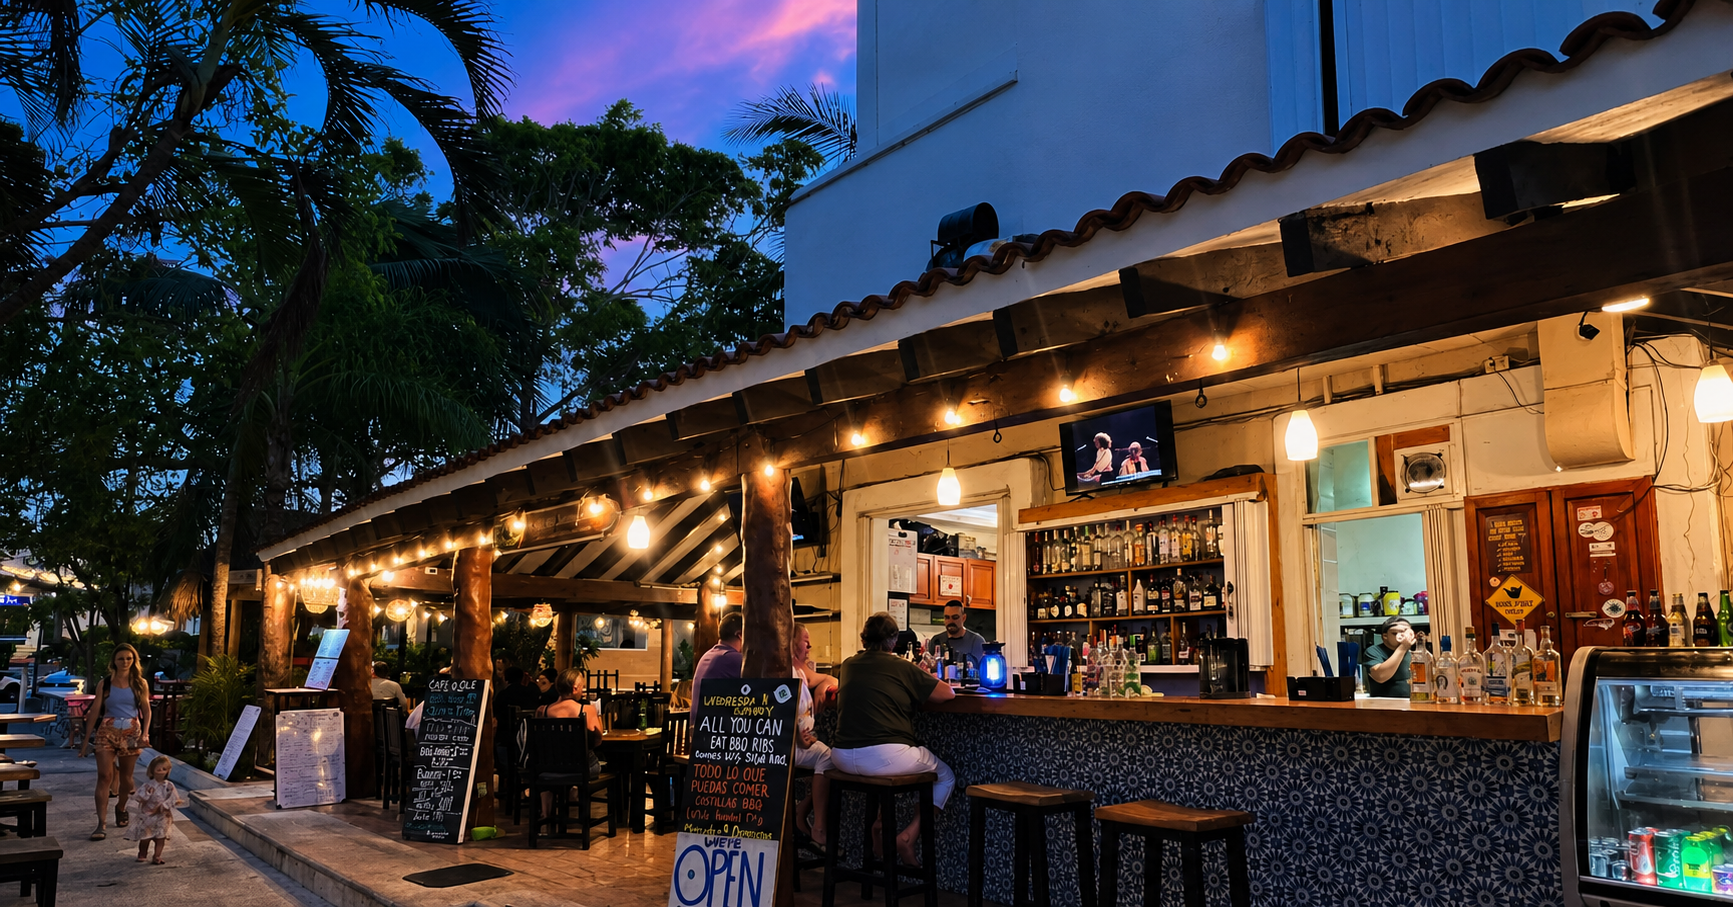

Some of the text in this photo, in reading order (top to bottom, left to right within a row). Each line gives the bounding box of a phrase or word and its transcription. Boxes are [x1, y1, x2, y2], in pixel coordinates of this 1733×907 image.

[700, 716, 783, 736] ALL YOU CAN
[710, 735, 727, 750] EAT
[752, 737, 774, 753] RIBS
[694, 764, 722, 779] TODO
[726, 765, 739, 780] LO
[691, 780, 769, 798] PUEDAS COMER
[674, 844, 765, 907] OPEN
